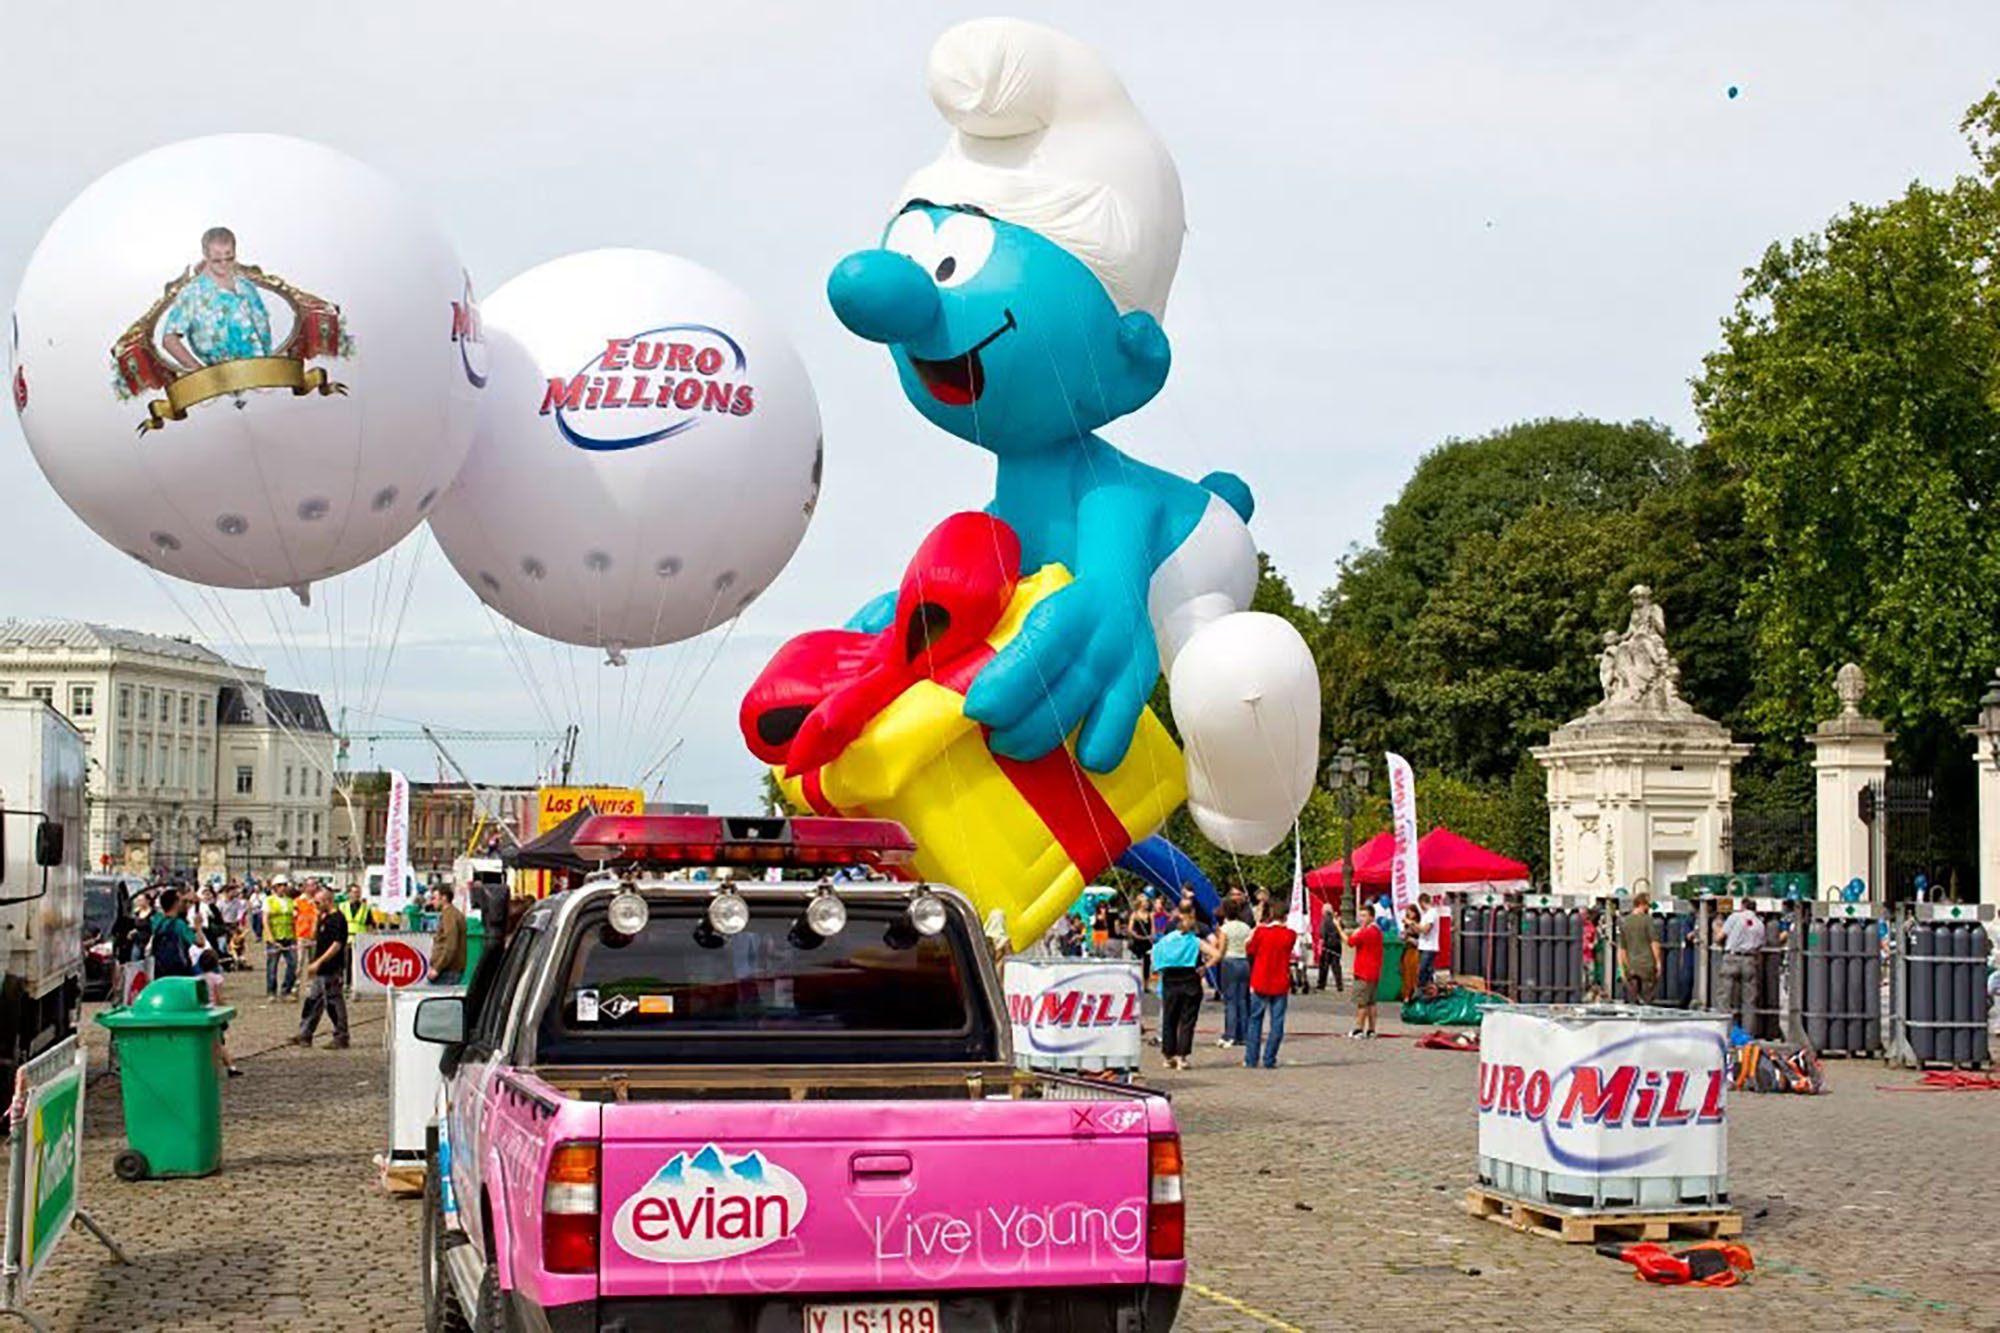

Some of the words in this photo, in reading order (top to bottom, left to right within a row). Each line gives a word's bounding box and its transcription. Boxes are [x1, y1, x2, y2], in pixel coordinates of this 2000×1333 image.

[599, 338, 725, 375] EURO
[545, 794, 573, 813] Los
[632, 1187, 790, 1241] evian
[876, 1213, 972, 1260] Live
[988, 1204, 1142, 1254] Young
